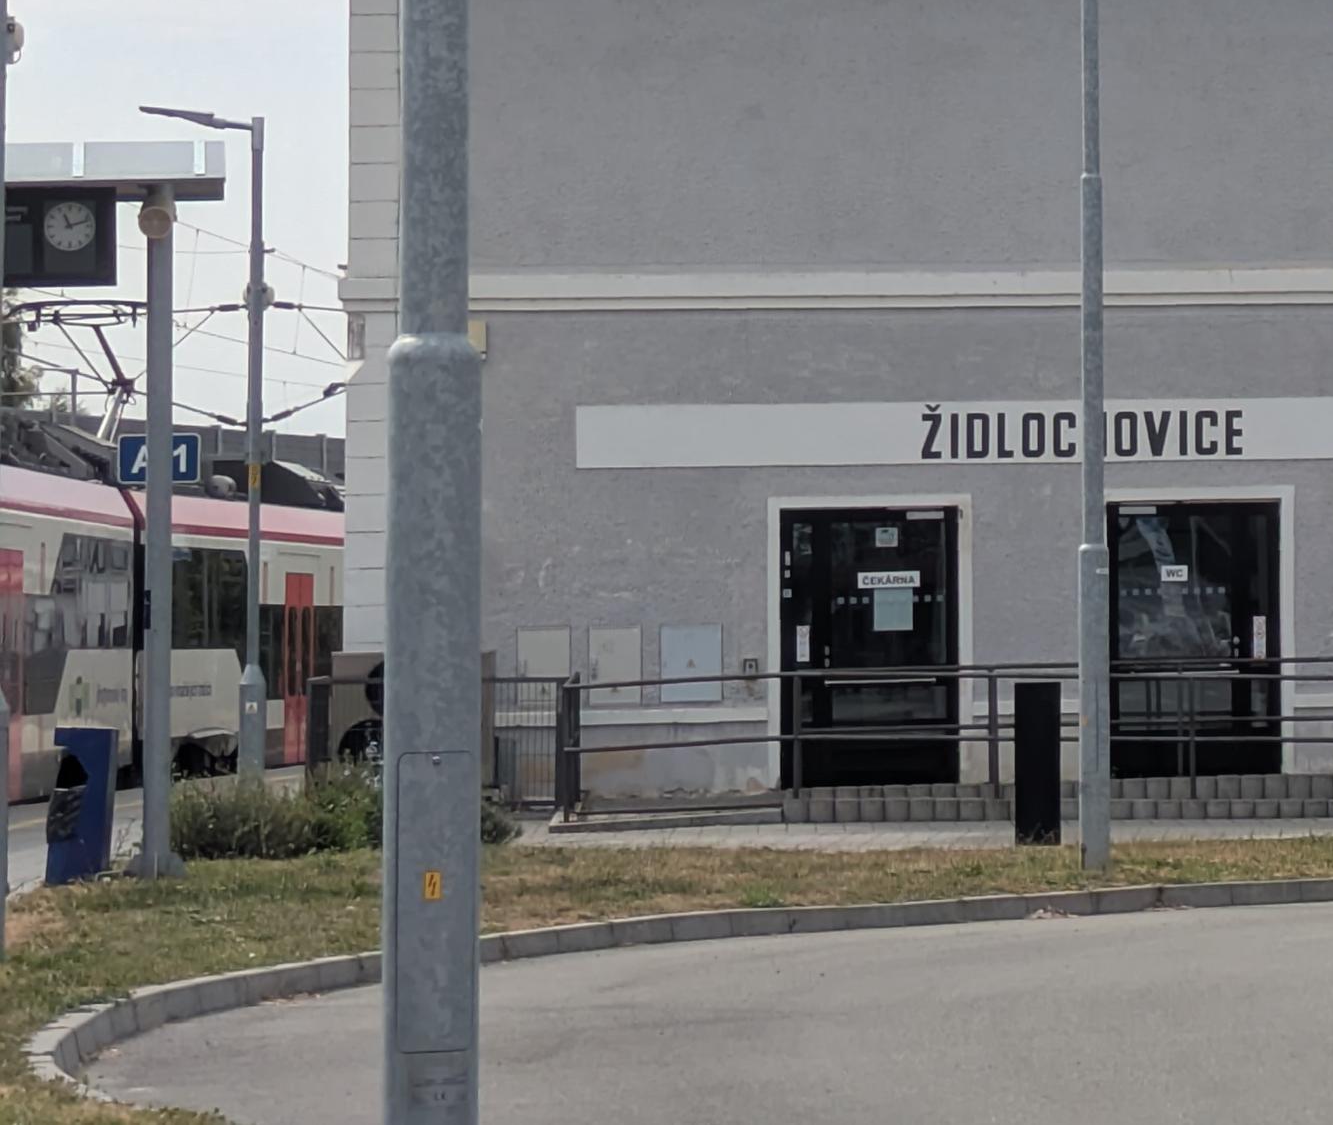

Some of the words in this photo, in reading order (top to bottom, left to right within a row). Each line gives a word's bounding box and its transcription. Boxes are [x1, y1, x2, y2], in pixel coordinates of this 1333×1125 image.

[921, 404, 1243, 460] ŽIDLOCOVICE
[1166, 569, 1183, 578] WC
[862, 574, 916, 586] ČEKÁRNA
